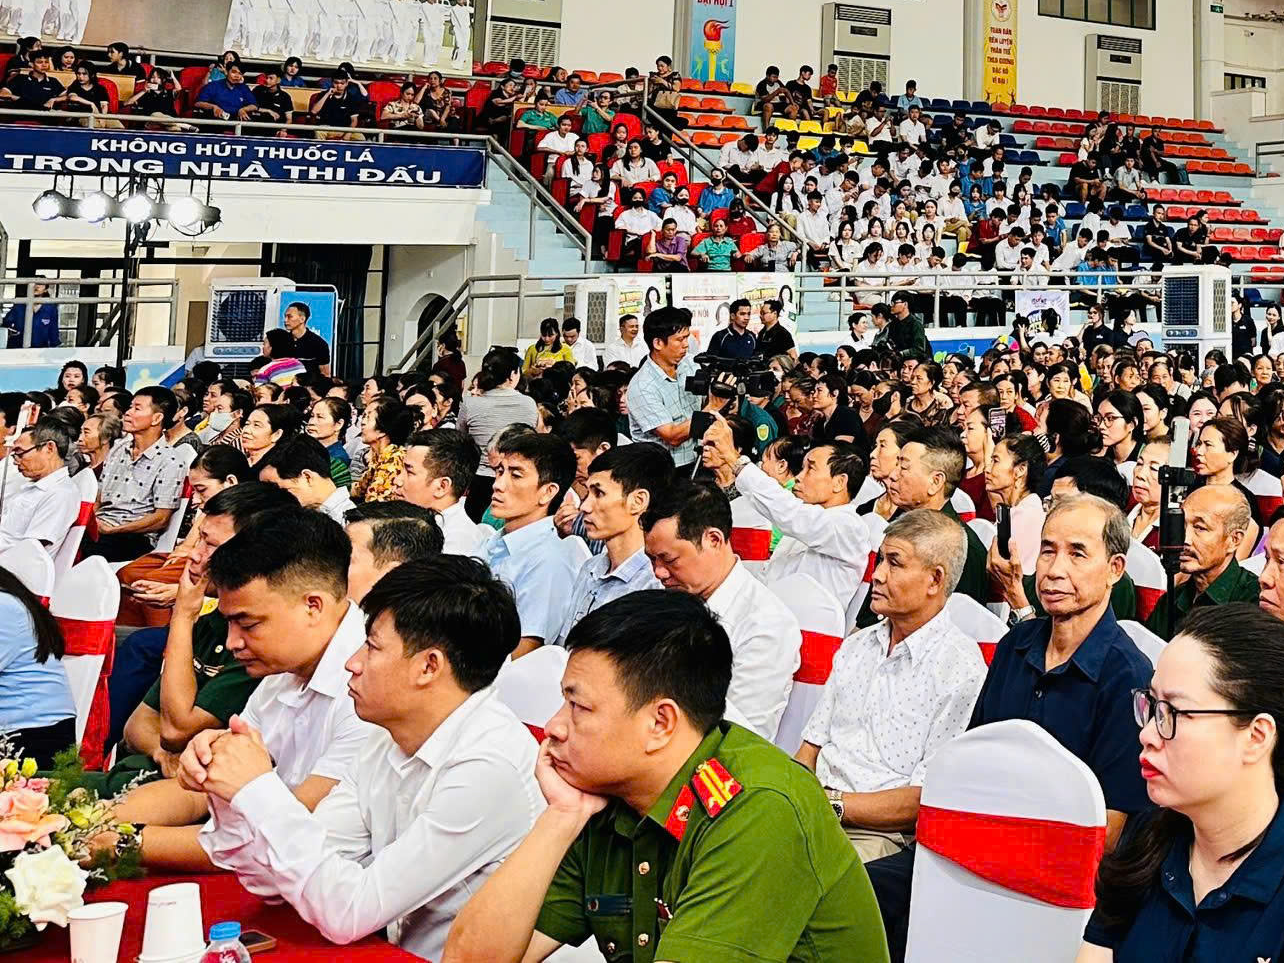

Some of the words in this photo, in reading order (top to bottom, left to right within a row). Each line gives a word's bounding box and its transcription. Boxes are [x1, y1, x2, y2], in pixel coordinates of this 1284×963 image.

[91, 137, 187, 155] KHÔNG
[195, 141, 248, 158] HÚT
[254, 144, 338, 162] THUỐC
[344, 148, 375, 163] LÁ
[4, 154, 164, 174] TRONG
[179, 160, 271, 179] NHÀ
[283, 165, 345, 181] THI
[357, 164, 442, 184] ĐẤU
